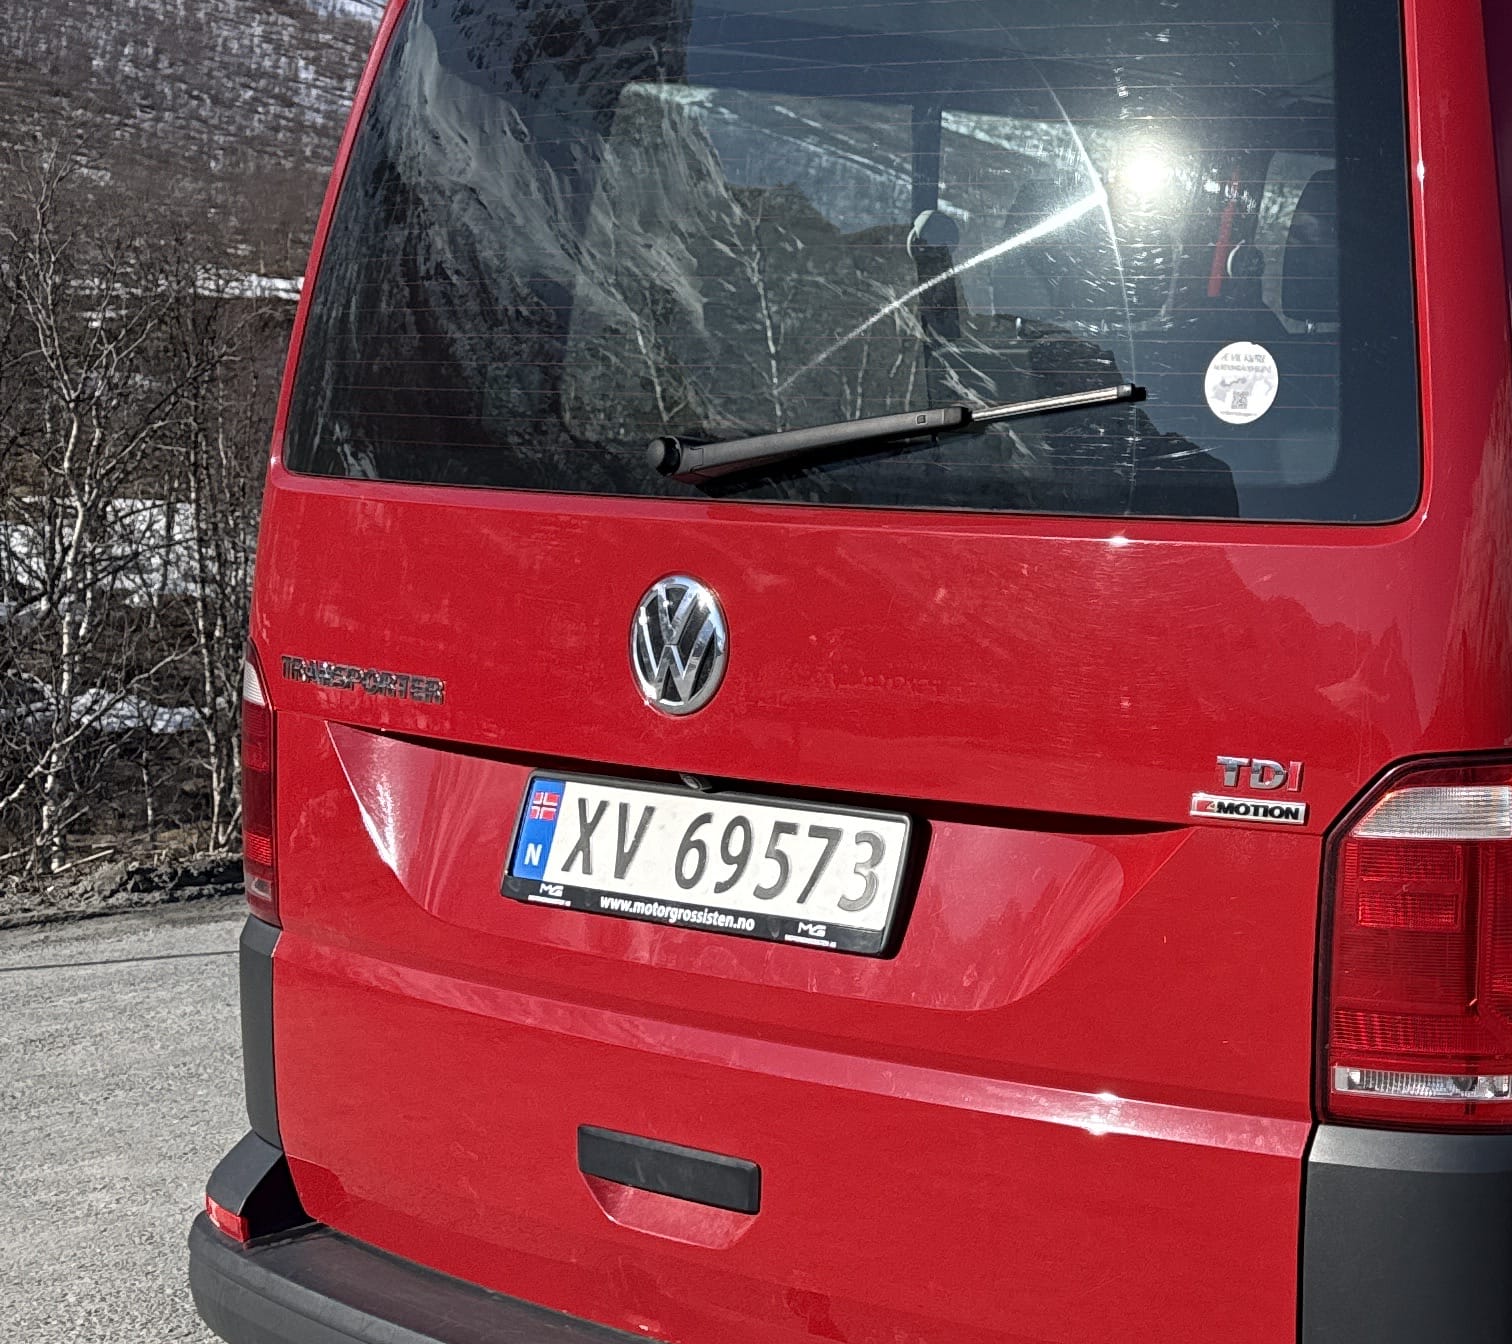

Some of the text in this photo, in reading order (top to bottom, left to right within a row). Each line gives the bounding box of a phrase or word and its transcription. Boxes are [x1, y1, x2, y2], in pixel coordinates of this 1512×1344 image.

[282, 655, 445, 705] TRANSPORTER
[1217, 755, 1303, 792] TDI
[523, 843, 543, 867] N
[561, 797, 887, 913] XV 69573
[599, 895, 756, 932] www.motorgrossisten.no
